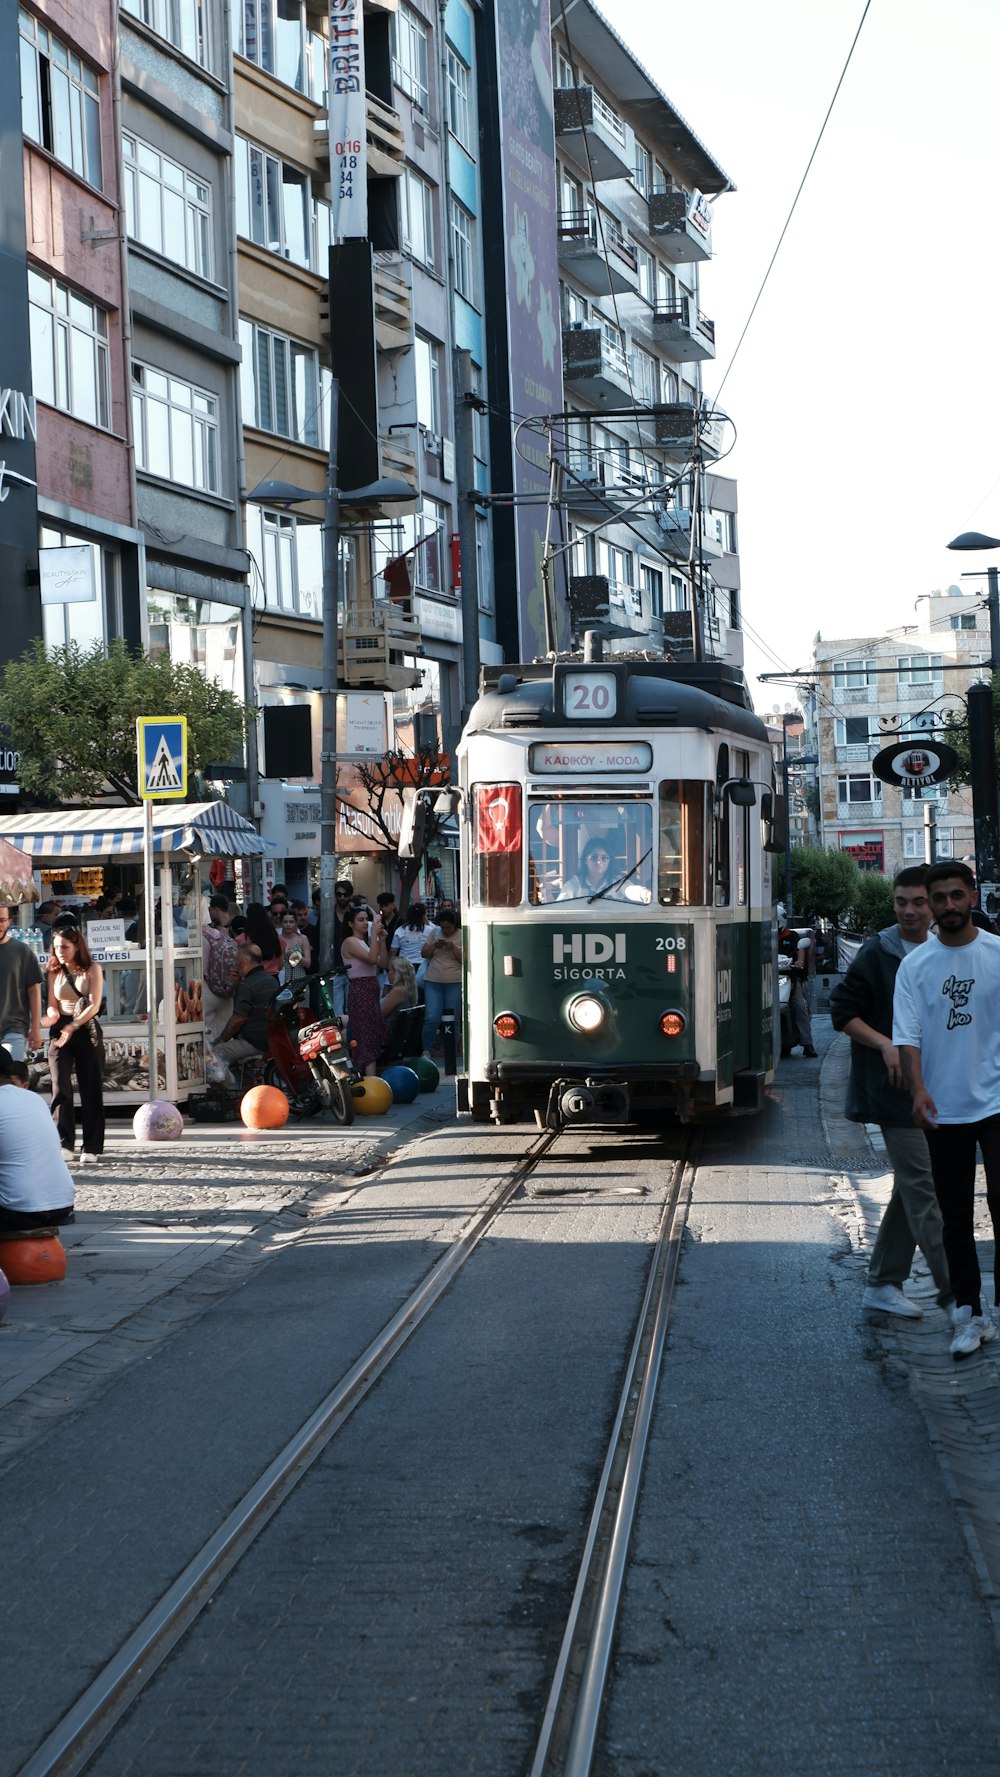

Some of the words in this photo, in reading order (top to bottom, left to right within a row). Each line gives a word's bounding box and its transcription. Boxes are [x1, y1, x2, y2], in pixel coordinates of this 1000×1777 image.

[335, 140, 361, 156] 016
[572, 684, 610, 711] 20
[544, 754, 595, 766] KADIKÖY
[606, 756, 640, 765] MODA
[90, 924, 112, 932] SOĞUK
[553, 933, 627, 964] HDI
[655, 937, 686, 951] 208
[553, 967, 627, 980] SİGORTA
[717, 969, 732, 1004] HDI
[103, 1038, 149, 1058] İMİT
